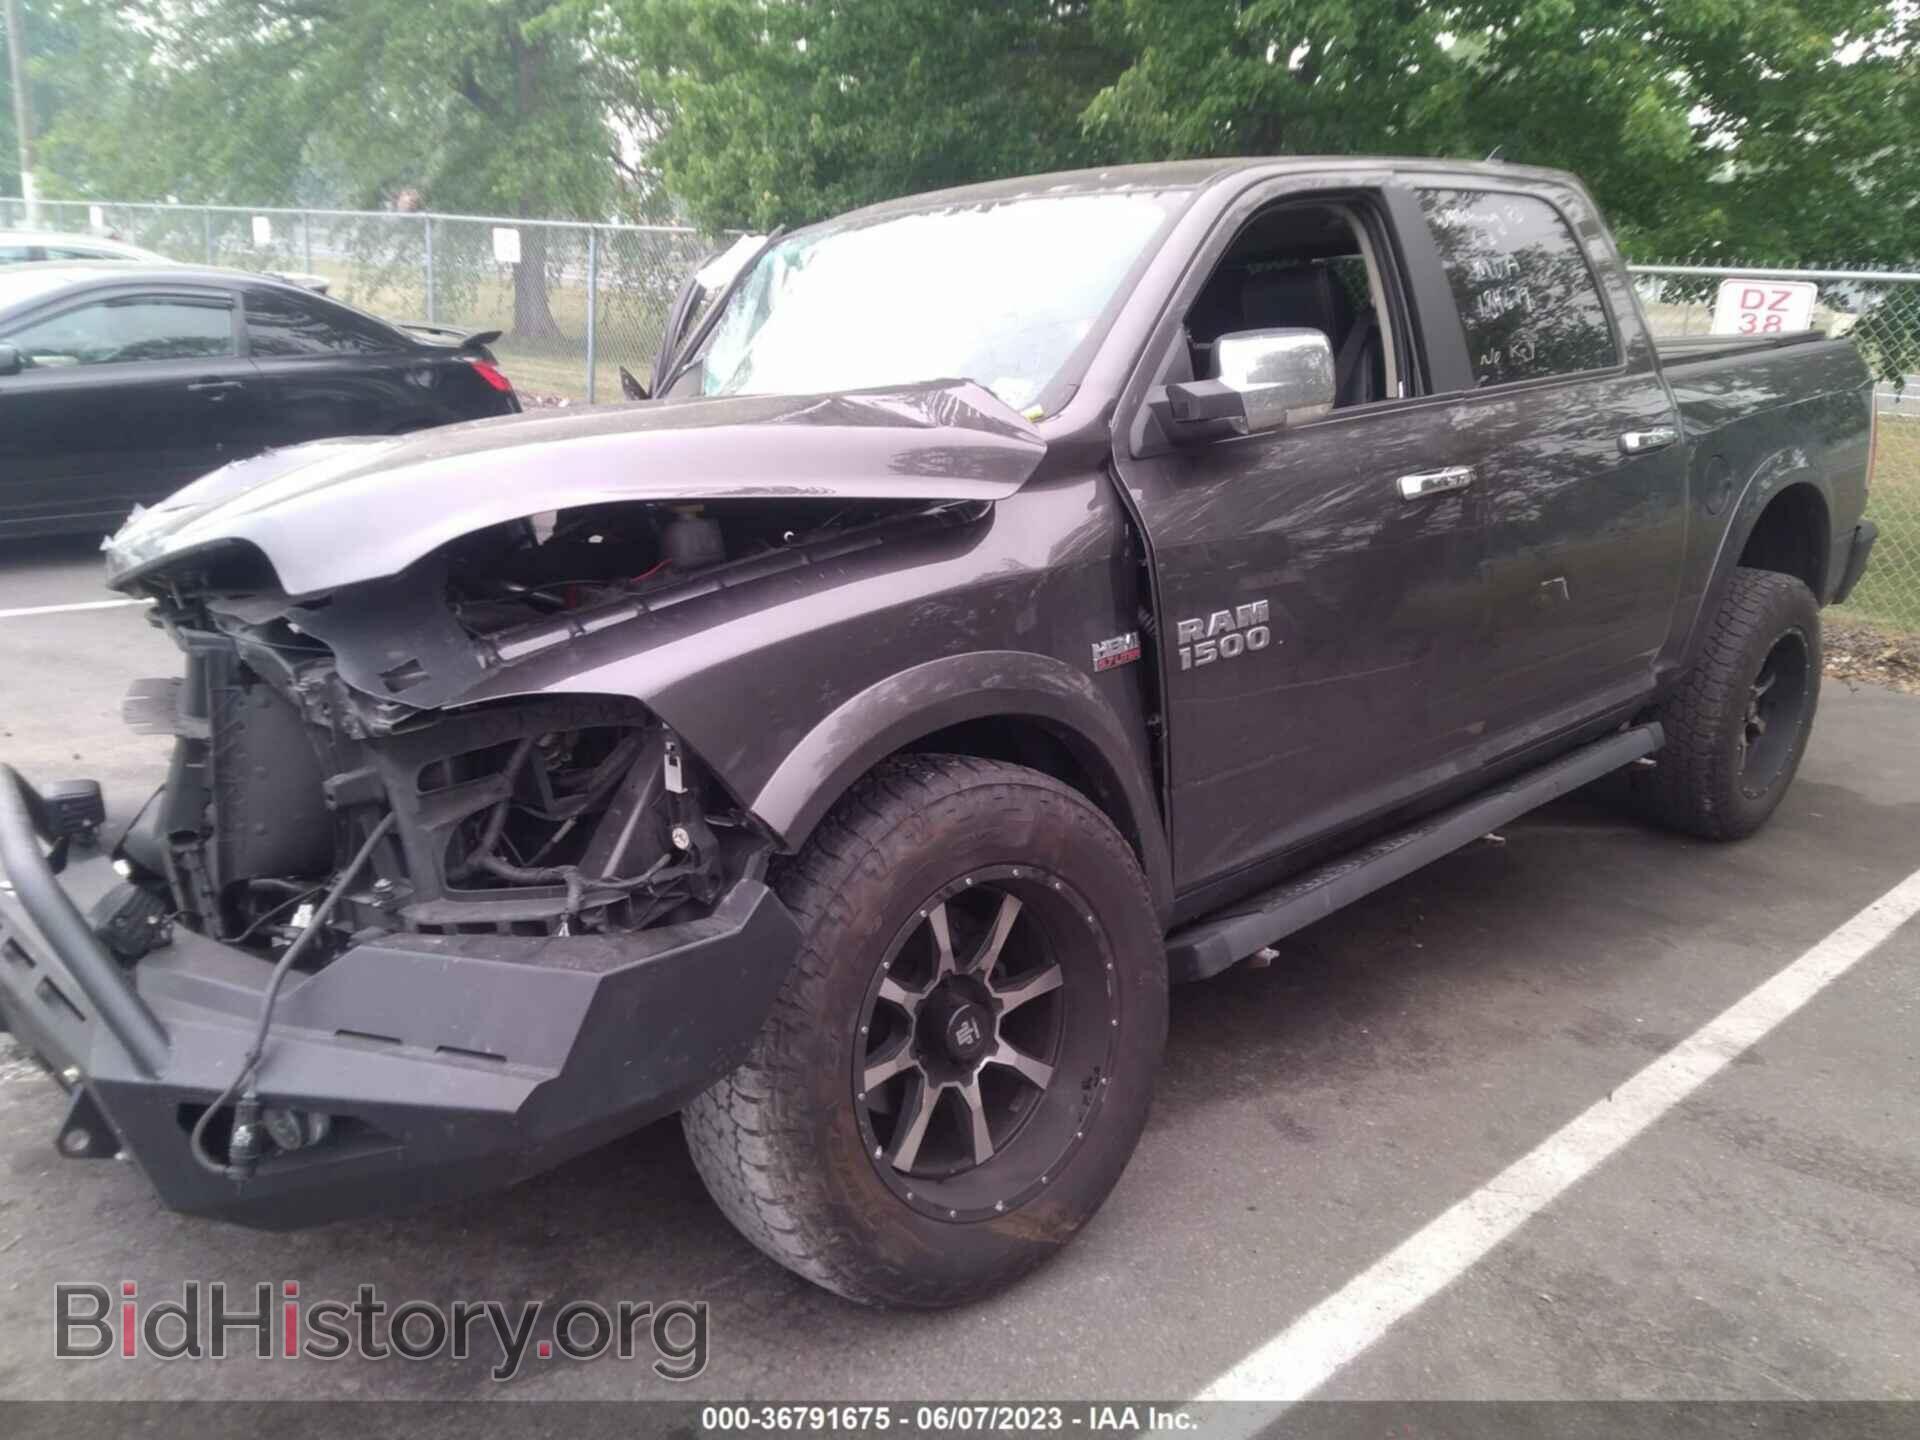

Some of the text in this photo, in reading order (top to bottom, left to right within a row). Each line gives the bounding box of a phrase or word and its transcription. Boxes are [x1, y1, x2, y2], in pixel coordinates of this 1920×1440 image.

[1740, 288, 1792, 312] DZ
[1738, 313, 1782, 335] 38
[1177, 599, 1270, 645] RAM
[1178, 625, 1271, 671] 1500
